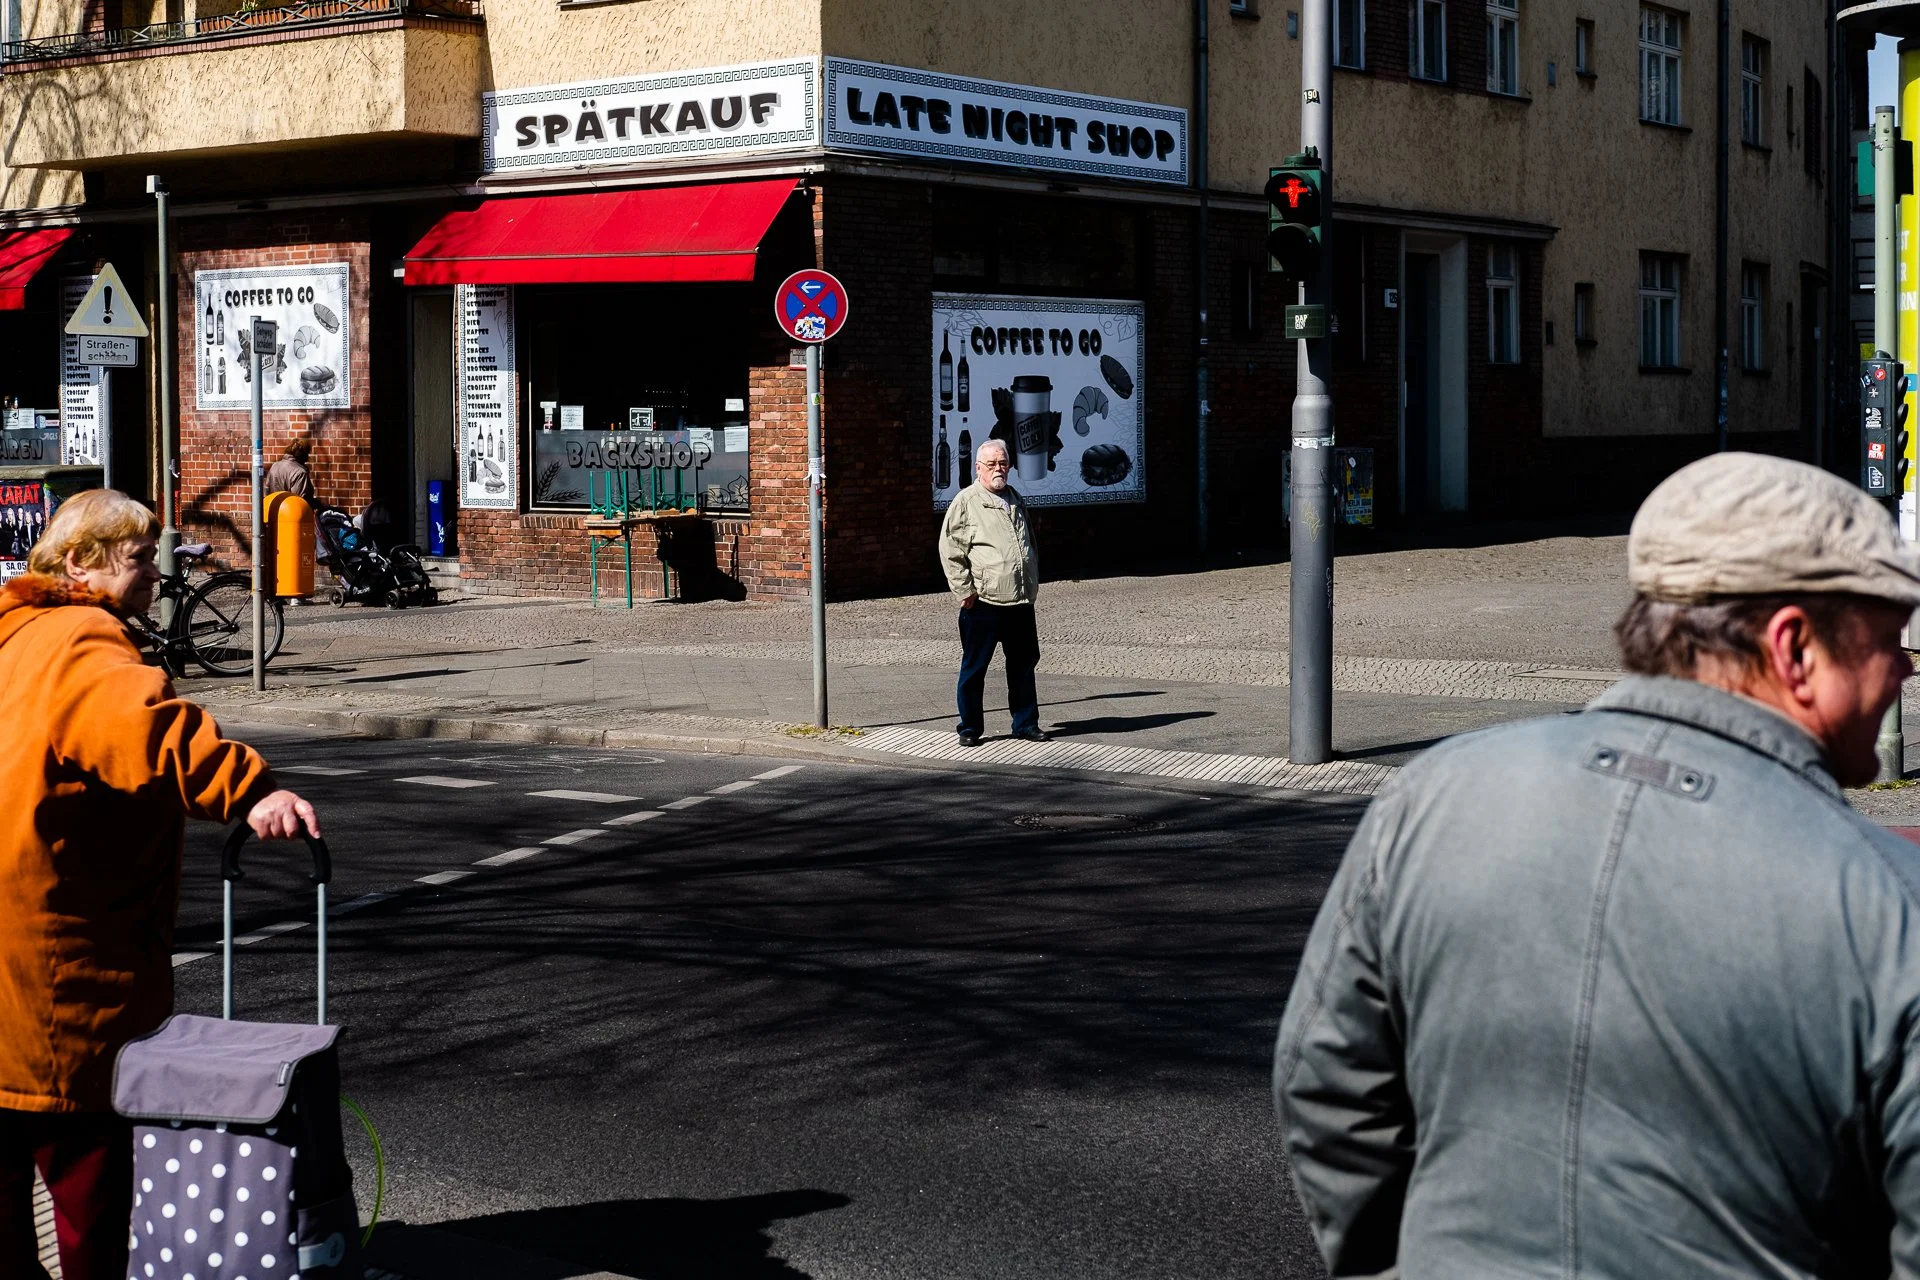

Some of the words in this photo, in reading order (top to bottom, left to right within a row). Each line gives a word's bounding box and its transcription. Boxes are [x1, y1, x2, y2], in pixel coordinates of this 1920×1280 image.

[515, 92, 781, 148] SPÄTKAUF
[846, 87, 951, 134] LATE
[961, 103, 1078, 151] NIGHT
[1086, 120, 1177, 162] SHOP
[225, 289, 273, 308] COFFEE
[276, 287, 293, 305] TO
[297, 285, 314, 304] GO
[86, 340, 130, 350] Straßen-
[970, 326, 1045, 356] COFFEE
[1049, 328, 1073, 356] TO
[1079, 328, 1102, 357] GO
[566, 441, 712, 470] BACKSHOP
